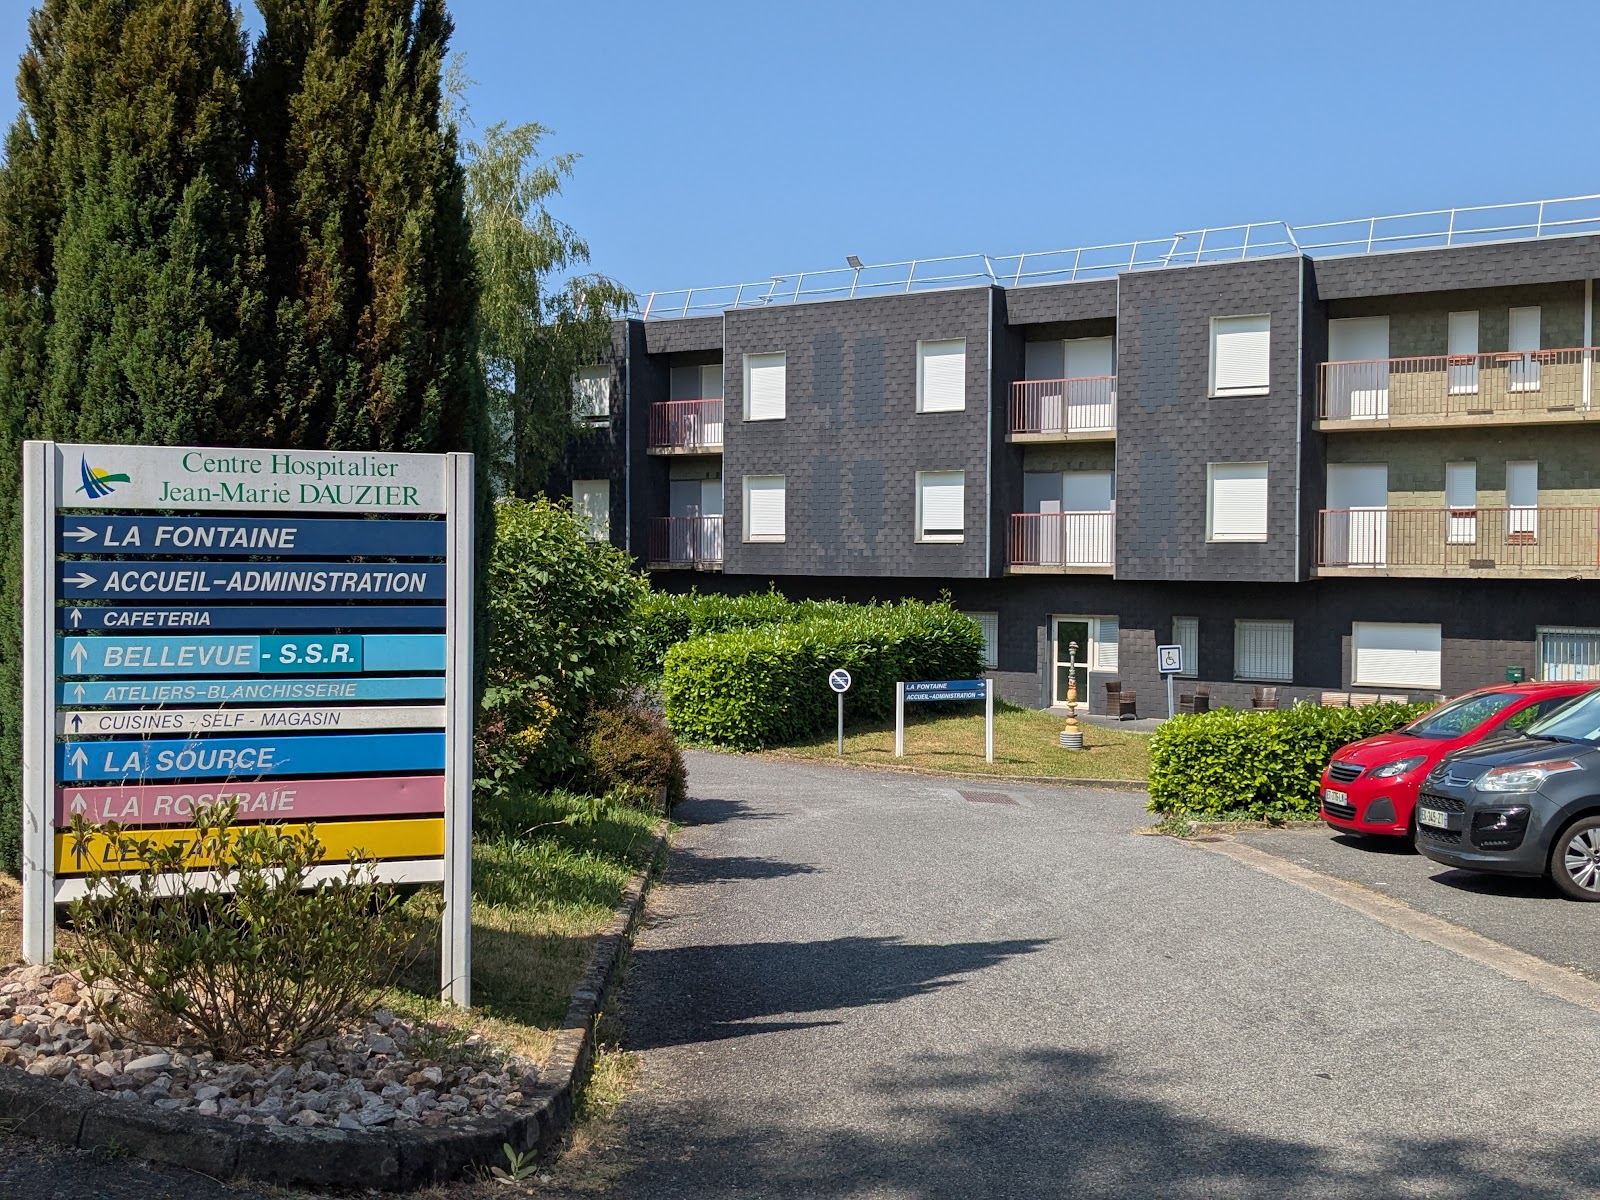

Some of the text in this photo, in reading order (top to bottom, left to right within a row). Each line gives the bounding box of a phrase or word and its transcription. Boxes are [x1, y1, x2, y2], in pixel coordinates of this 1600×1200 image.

[182, 451, 398, 481] Centre Hospitalier
[158, 481, 421, 506] Jean-Marie DAUZIER
[103, 525, 298, 549] LA FONTAINE
[103, 571, 427, 593] ACCUEIL-ADMINISTRATION
[103, 611, 211, 627] CAFETERIA
[103, 645, 254, 668] BELLEVUE
[279, 643, 355, 665] S.S.R.
[103, 683, 358, 701] ATELIERS-BLANCHISSERIE
[916, 682, 948, 690] FONTAINE
[99, 714, 184, 730] CUISINES
[201, 713, 244, 728] SELF
[260, 711, 341, 727] MAGASIN
[103, 747, 276, 772] LA SOURCE
[102, 796, 139, 818] LA
[102, 839, 157, 863] LE
